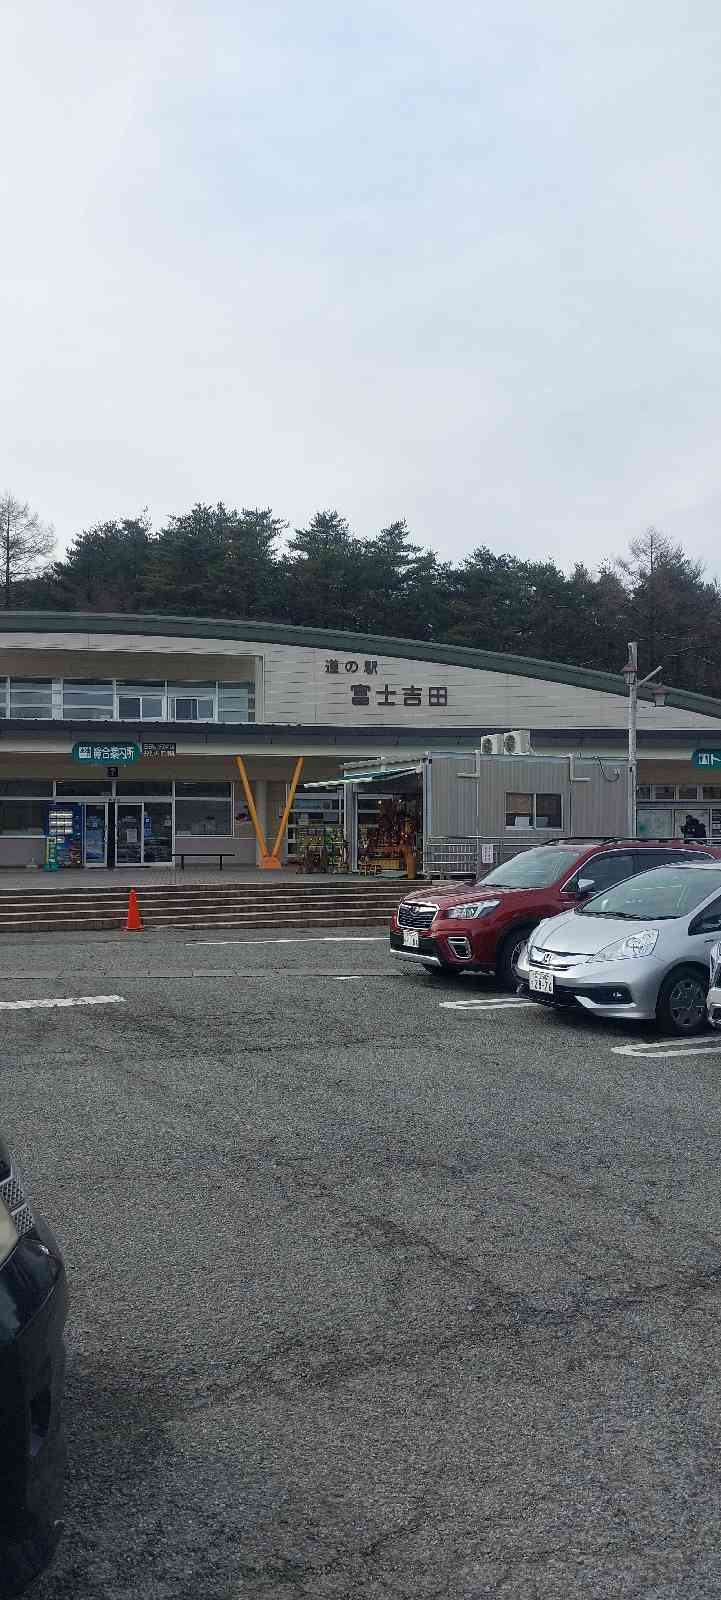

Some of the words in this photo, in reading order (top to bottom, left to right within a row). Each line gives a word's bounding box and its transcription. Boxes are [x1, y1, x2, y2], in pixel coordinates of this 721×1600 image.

[325, 659, 378, 675] 道の駅
[350, 683, 448, 707] 富士吉田
